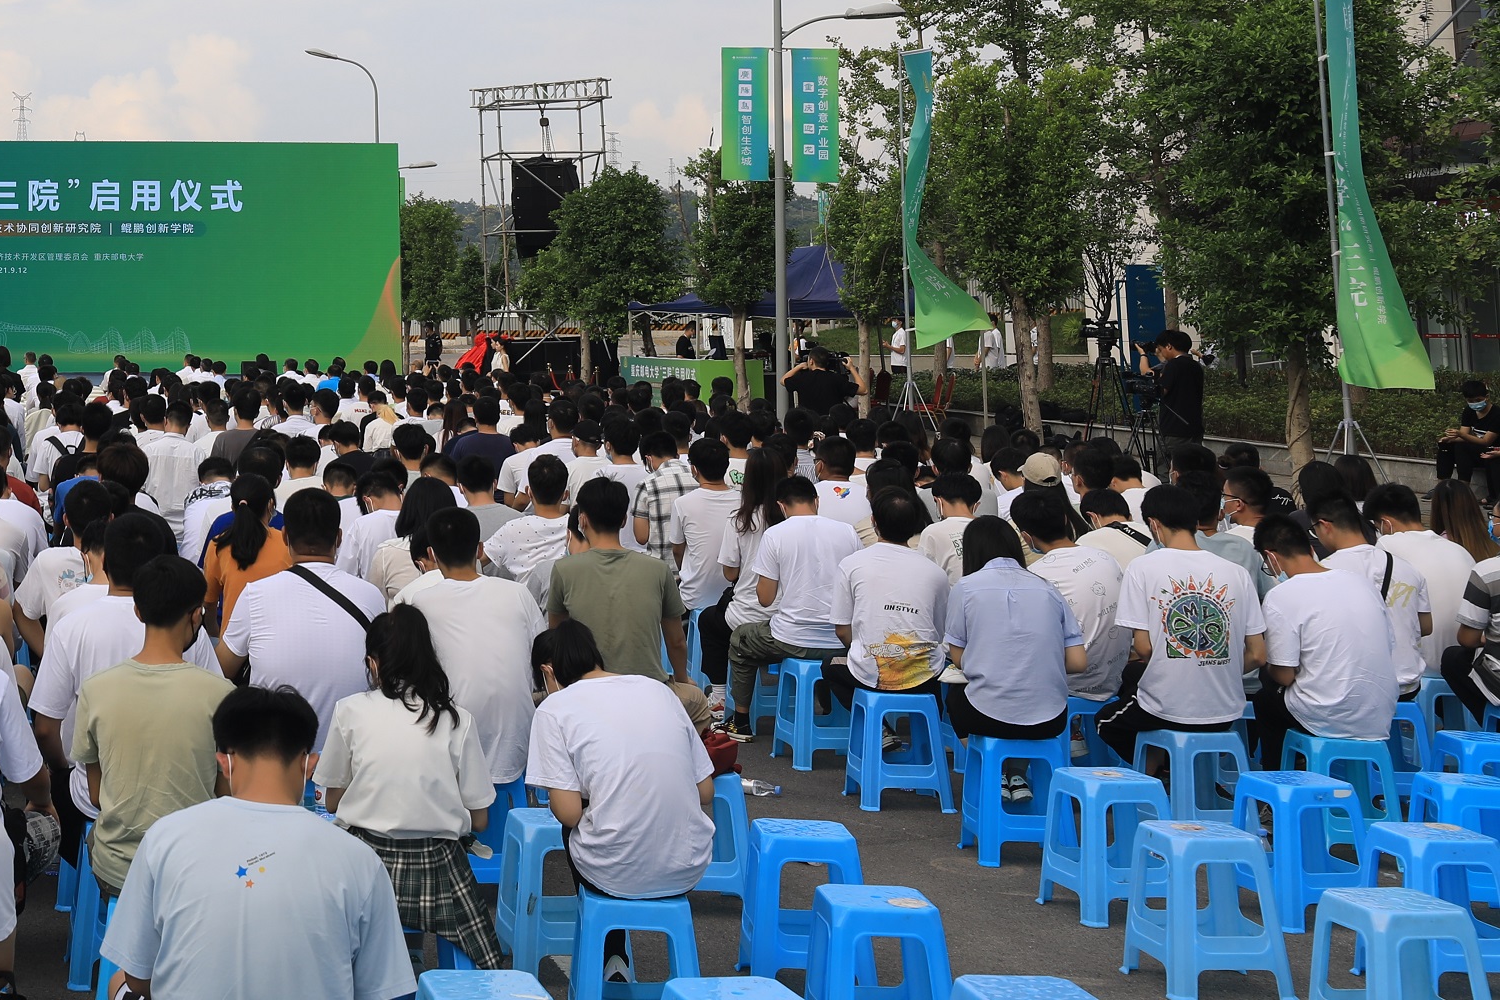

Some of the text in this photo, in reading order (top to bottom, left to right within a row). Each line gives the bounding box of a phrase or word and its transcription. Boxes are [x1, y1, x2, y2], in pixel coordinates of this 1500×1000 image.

[817, 76, 829, 160] 数字创意产业园
[120, 222, 195, 235] 鲲鹏创新学院
[895, 605, 920, 615] STYLE
